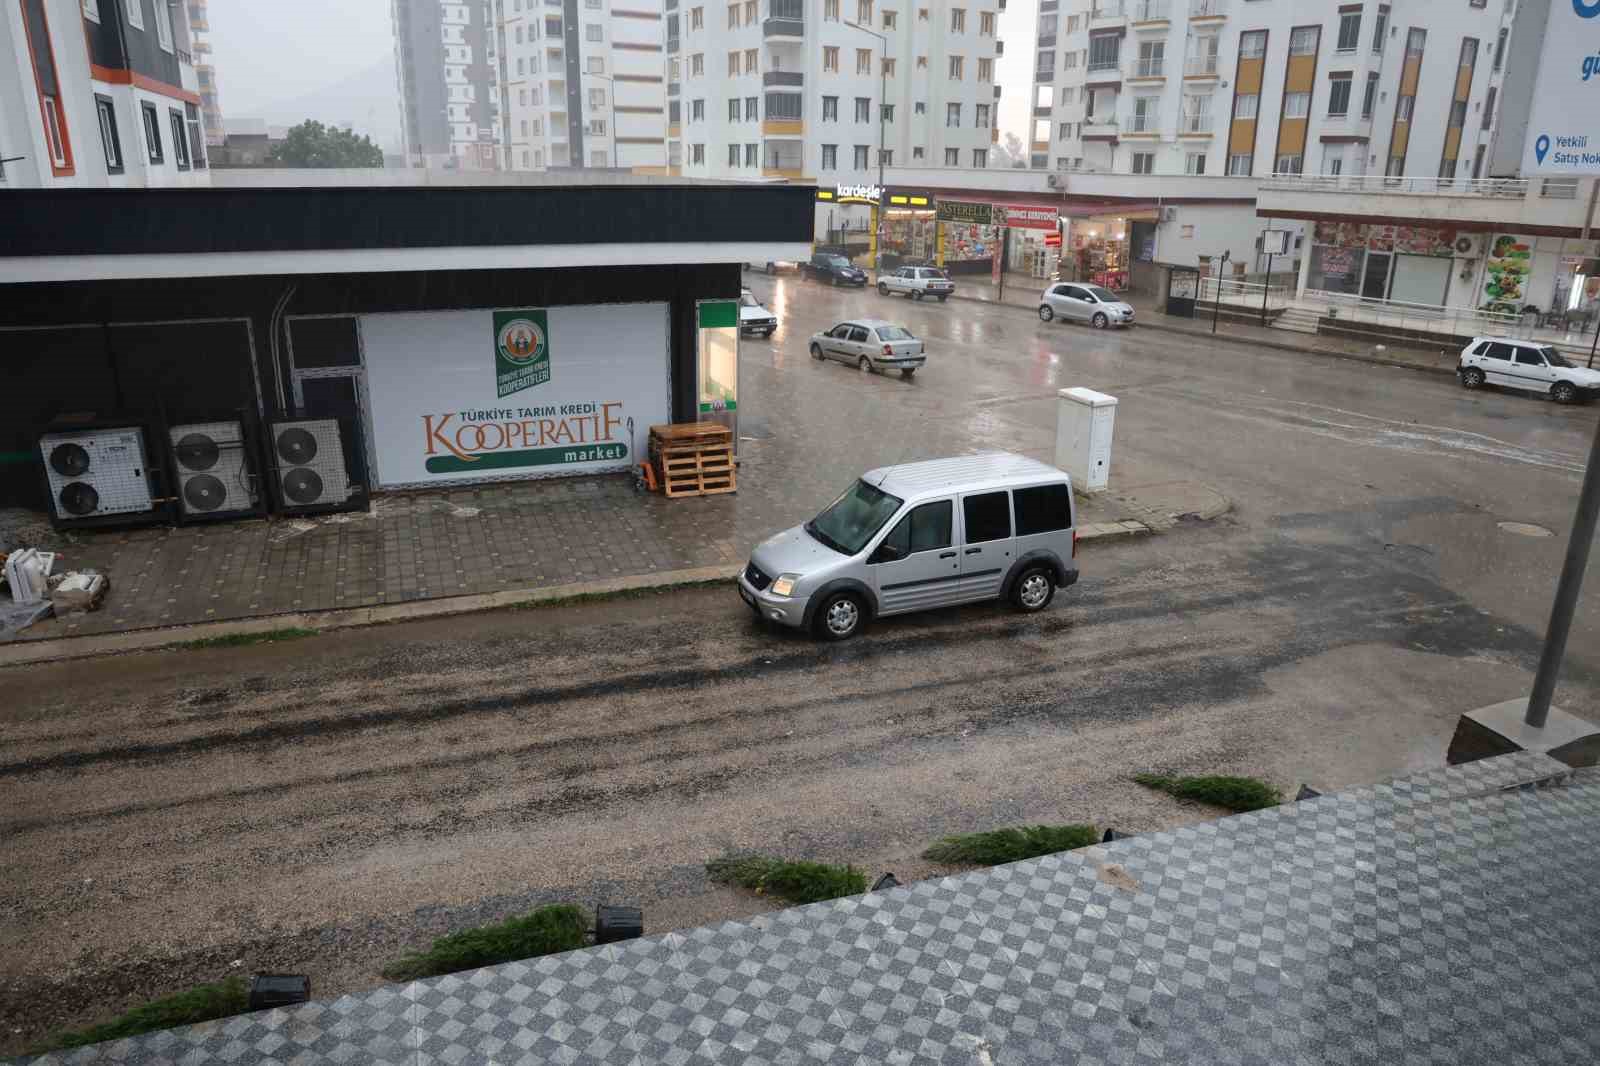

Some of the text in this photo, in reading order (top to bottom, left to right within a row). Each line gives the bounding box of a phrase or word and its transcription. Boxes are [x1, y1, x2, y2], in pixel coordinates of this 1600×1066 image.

[1556, 136, 1588, 148] Yetkili
[1554, 152, 1580, 166] Satış
[460, 401, 596, 422] TÜRKİYE TARIM KREDİ
[421, 400, 622, 462] KOOPERATİF
[564, 445, 622, 462] market
